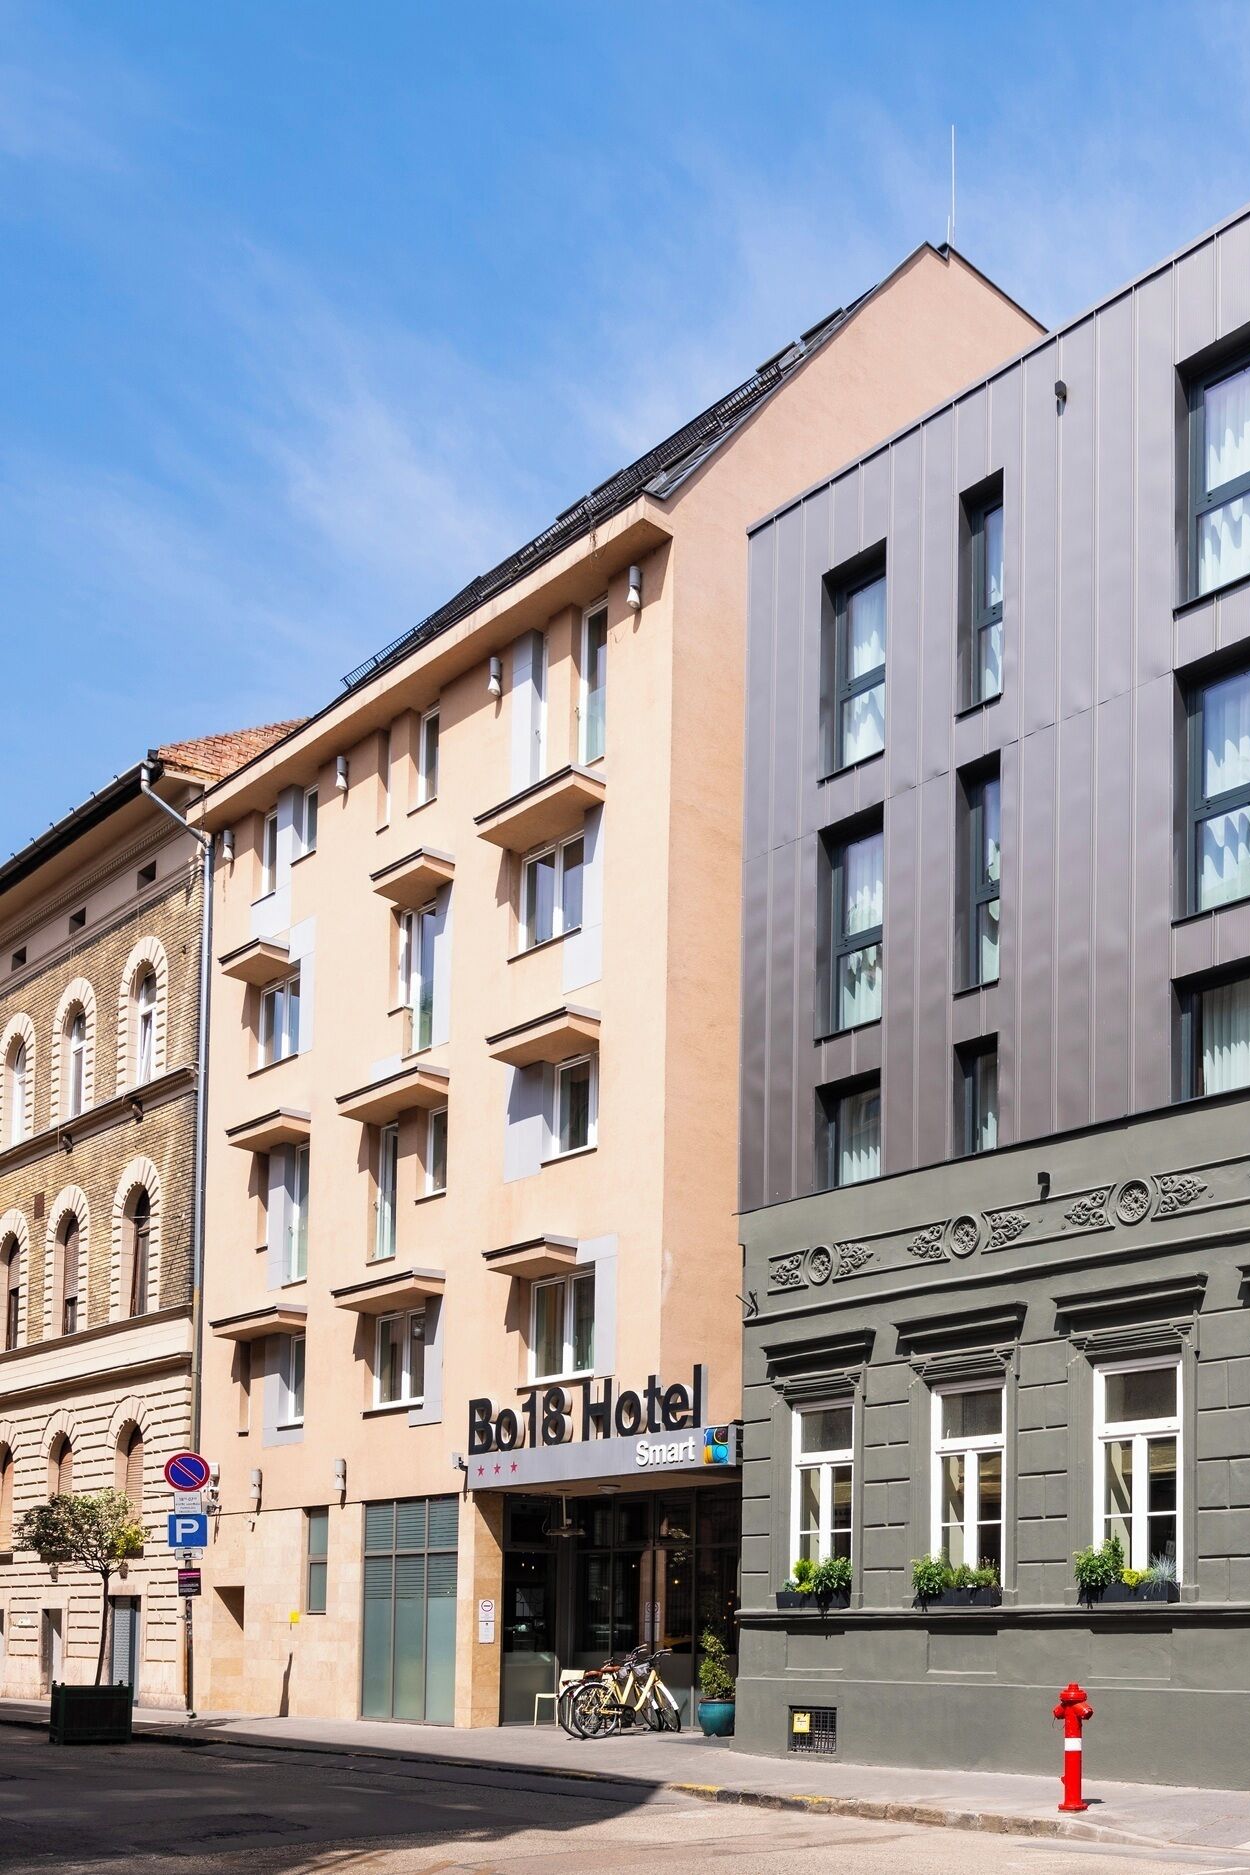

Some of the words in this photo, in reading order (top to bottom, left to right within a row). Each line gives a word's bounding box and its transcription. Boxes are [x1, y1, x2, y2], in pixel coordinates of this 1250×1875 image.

[469, 1387, 572, 1455] Bo18
[582, 1364, 708, 1441] Hotel
[636, 1437, 695, 1466] Smart
[176, 1519, 199, 1543] P
